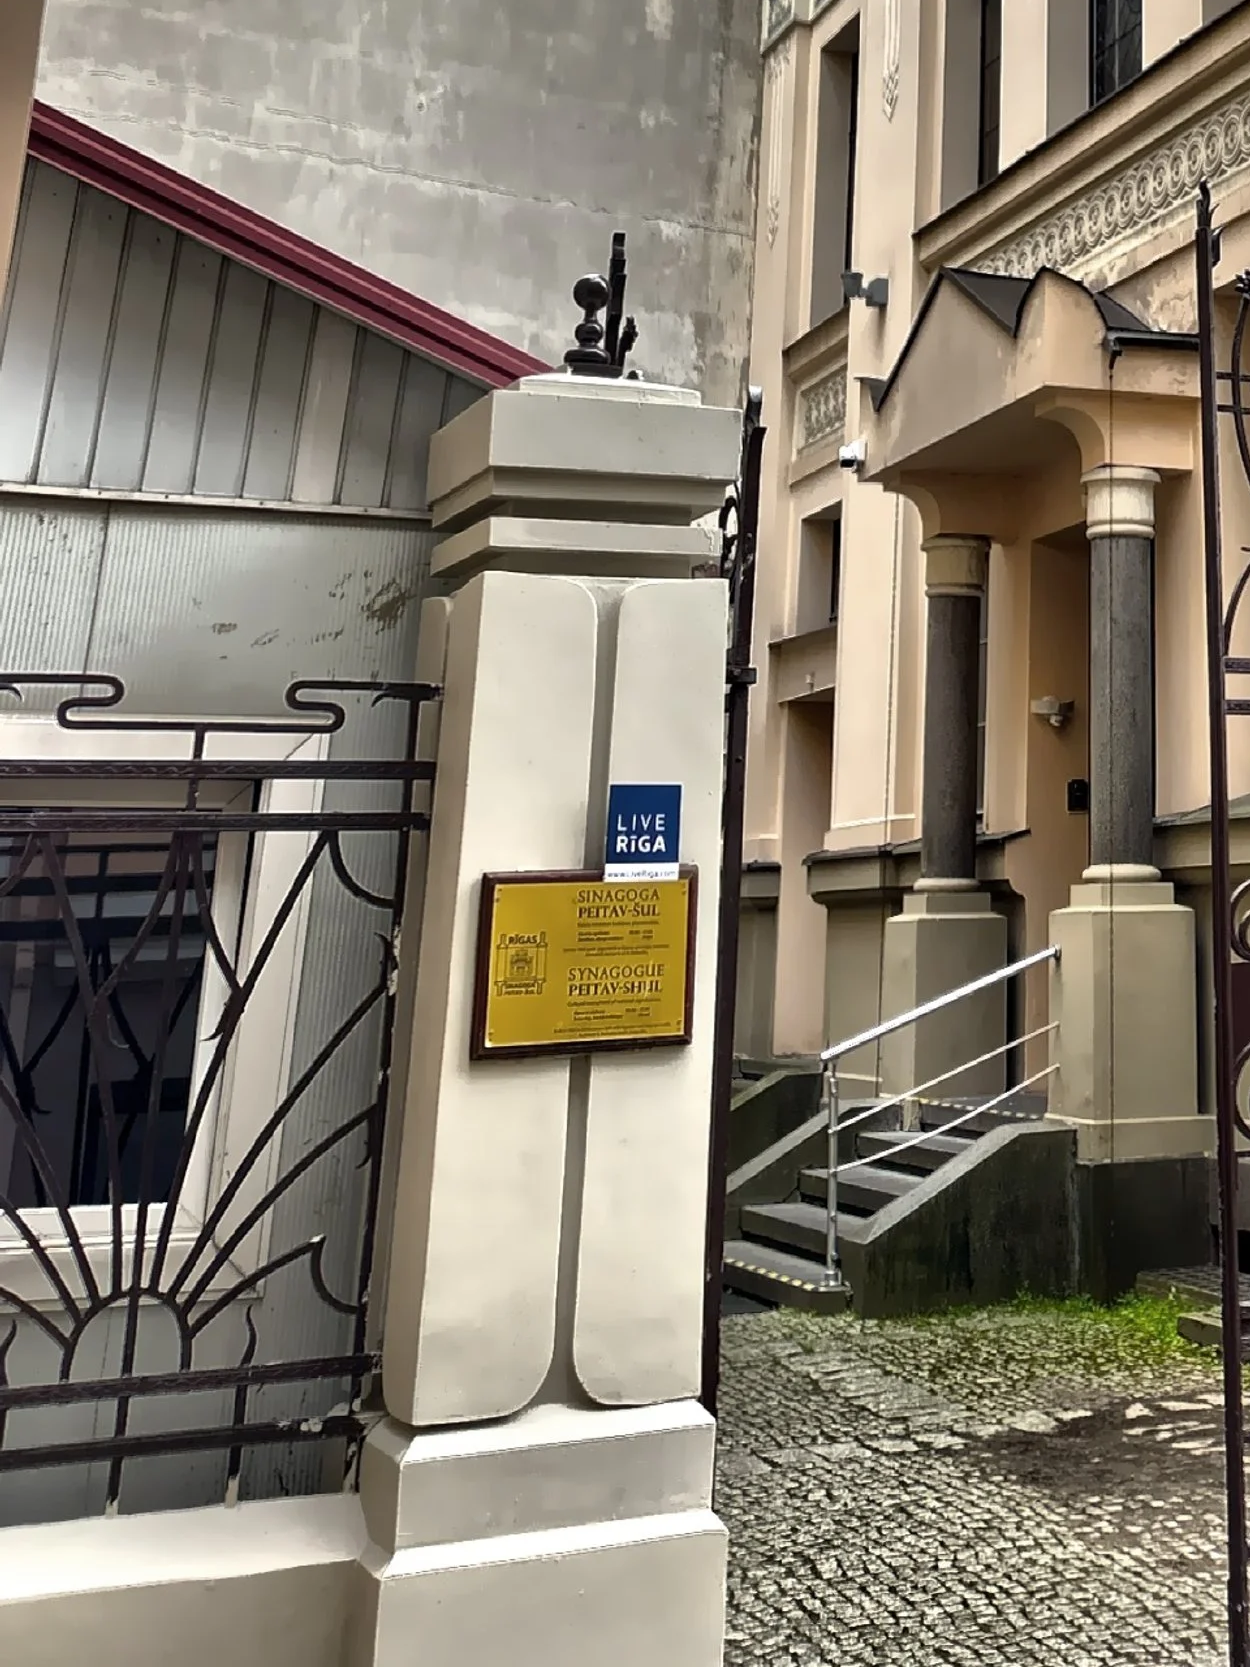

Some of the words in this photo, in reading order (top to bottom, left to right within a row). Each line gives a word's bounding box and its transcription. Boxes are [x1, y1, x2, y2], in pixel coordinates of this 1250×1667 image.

[617, 813, 666, 831] LIVE
[577, 888, 660, 903] SINAGOGA
[578, 902, 660, 919] PEITAV-ŠUL
[567, 963, 665, 982] SYNAGOGUE
